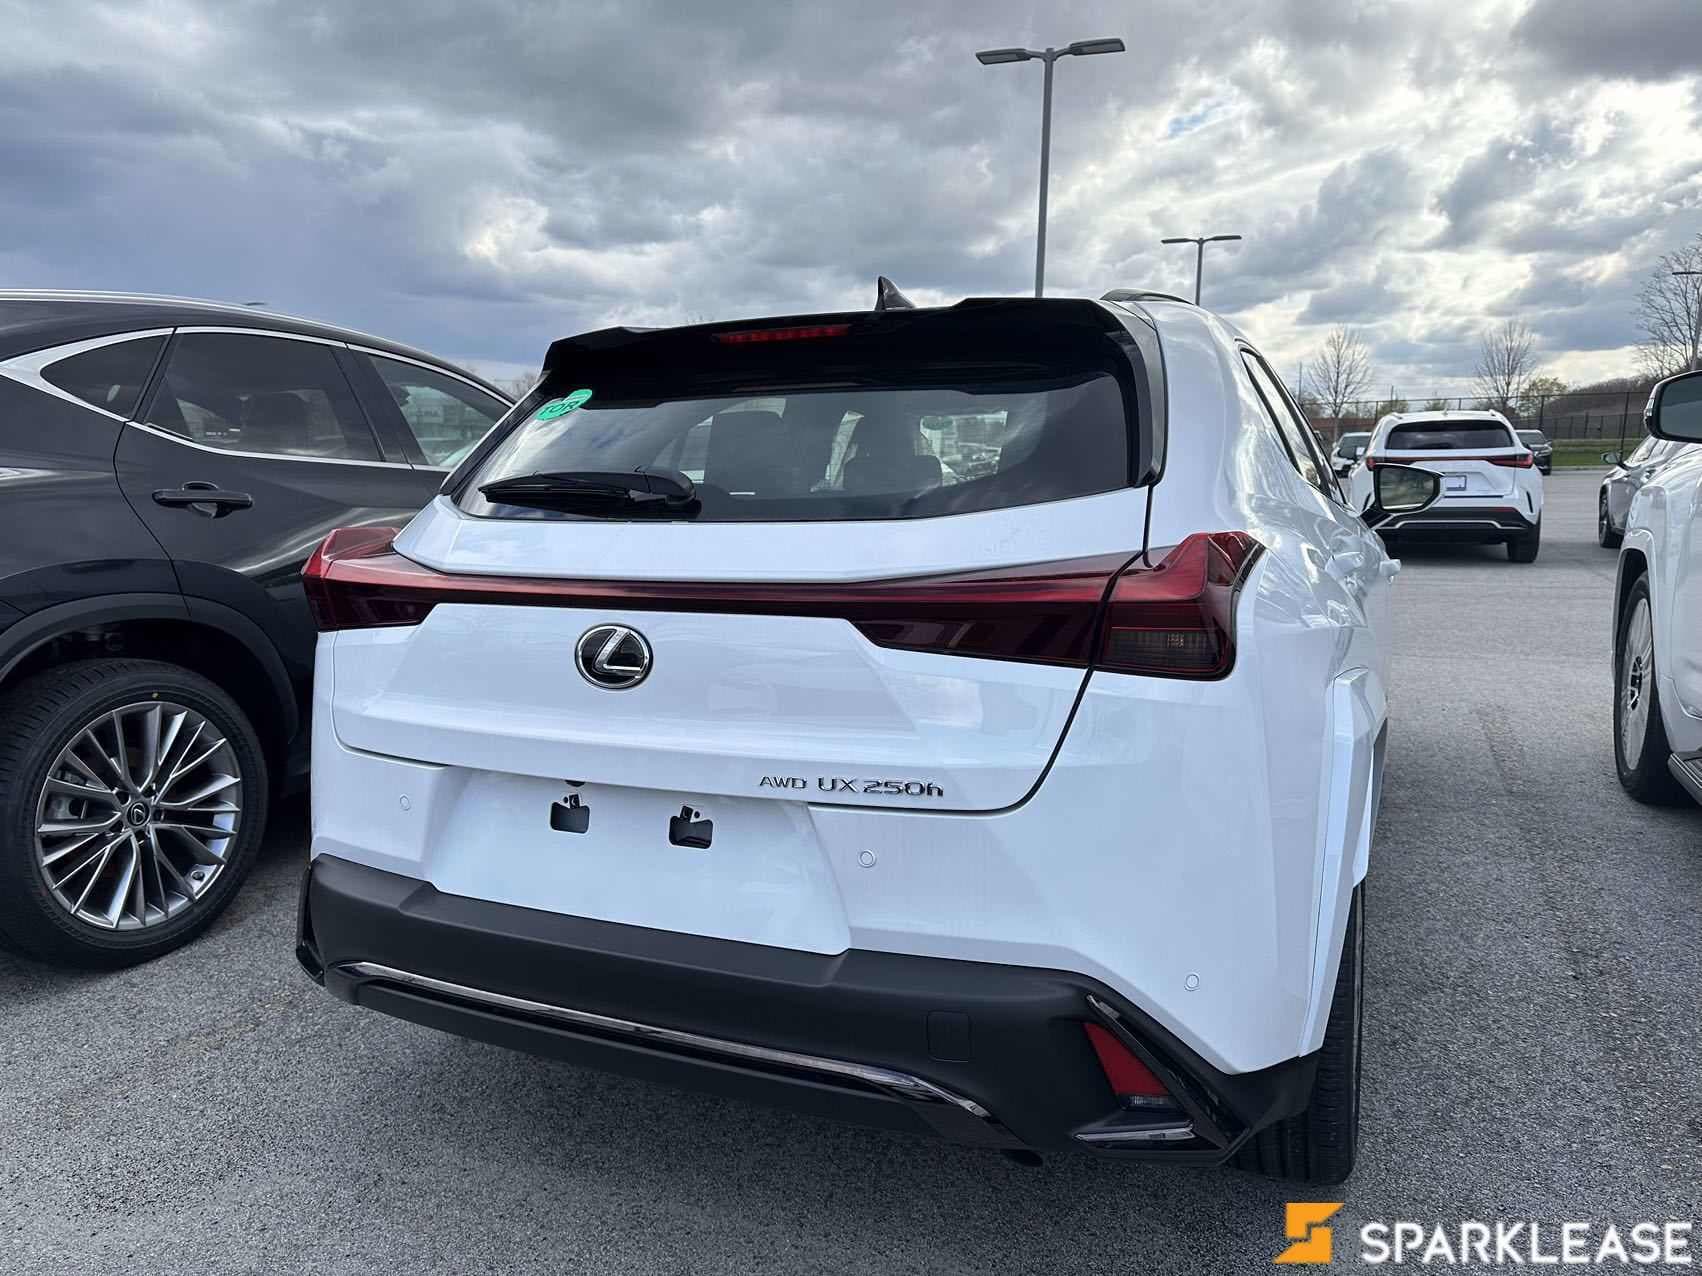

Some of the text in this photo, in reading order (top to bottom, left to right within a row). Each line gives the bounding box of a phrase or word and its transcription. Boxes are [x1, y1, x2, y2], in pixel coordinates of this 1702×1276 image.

[759, 776, 944, 797] AWD UX 250h
